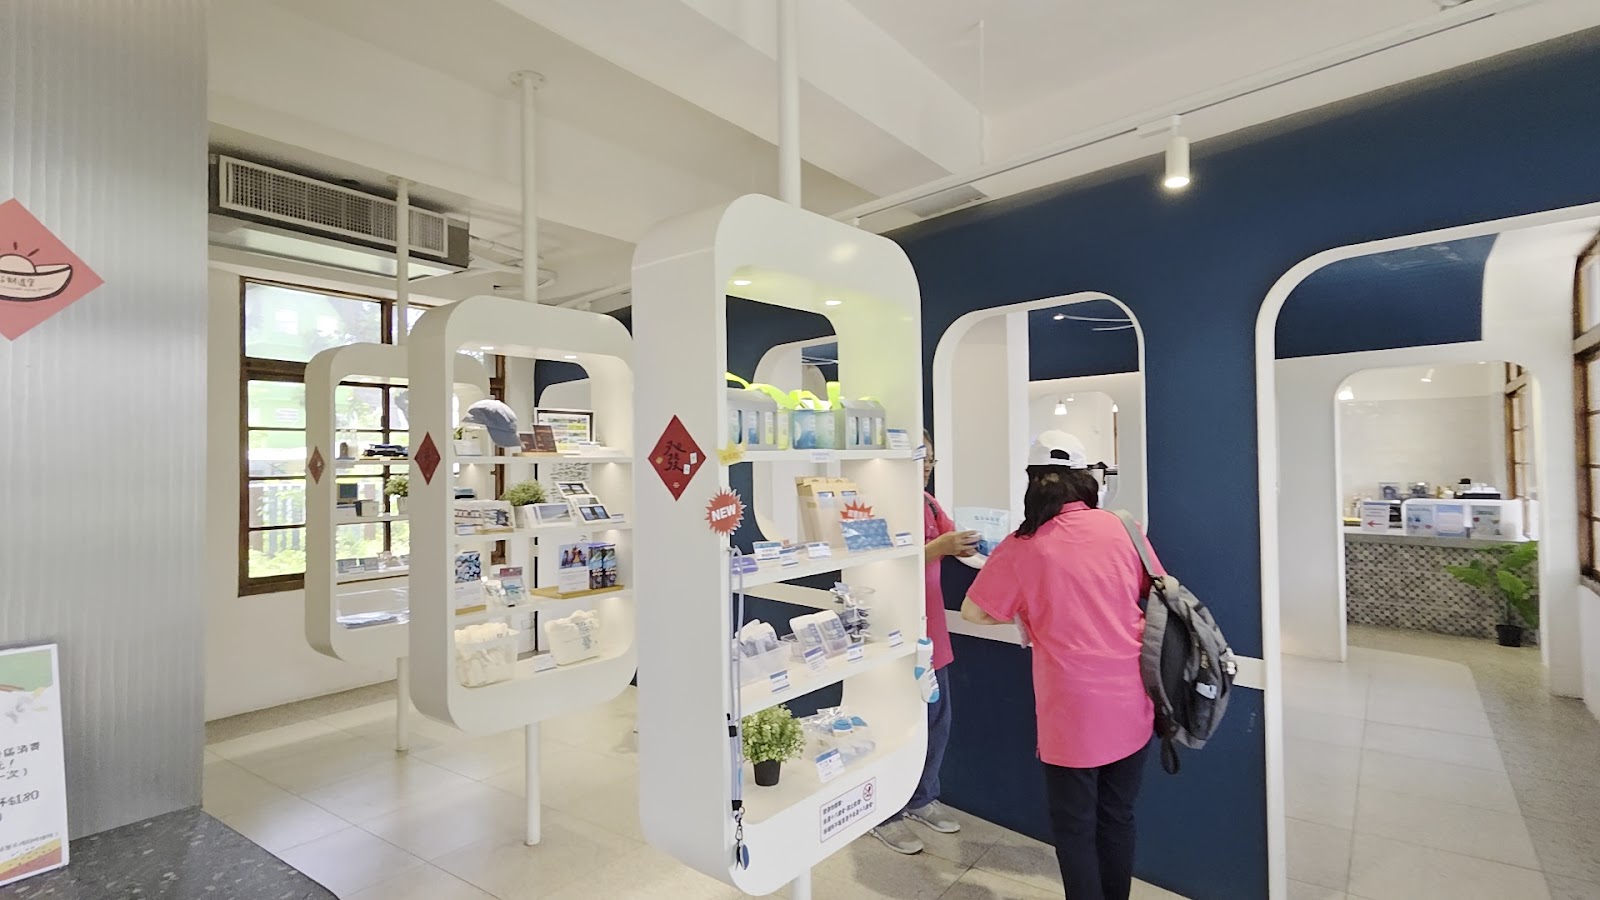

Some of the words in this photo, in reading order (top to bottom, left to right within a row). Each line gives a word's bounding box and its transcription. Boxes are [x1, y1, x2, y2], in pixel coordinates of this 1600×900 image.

[711, 503, 737, 522] NEW
[0, 741, 40, 759] 區消費
